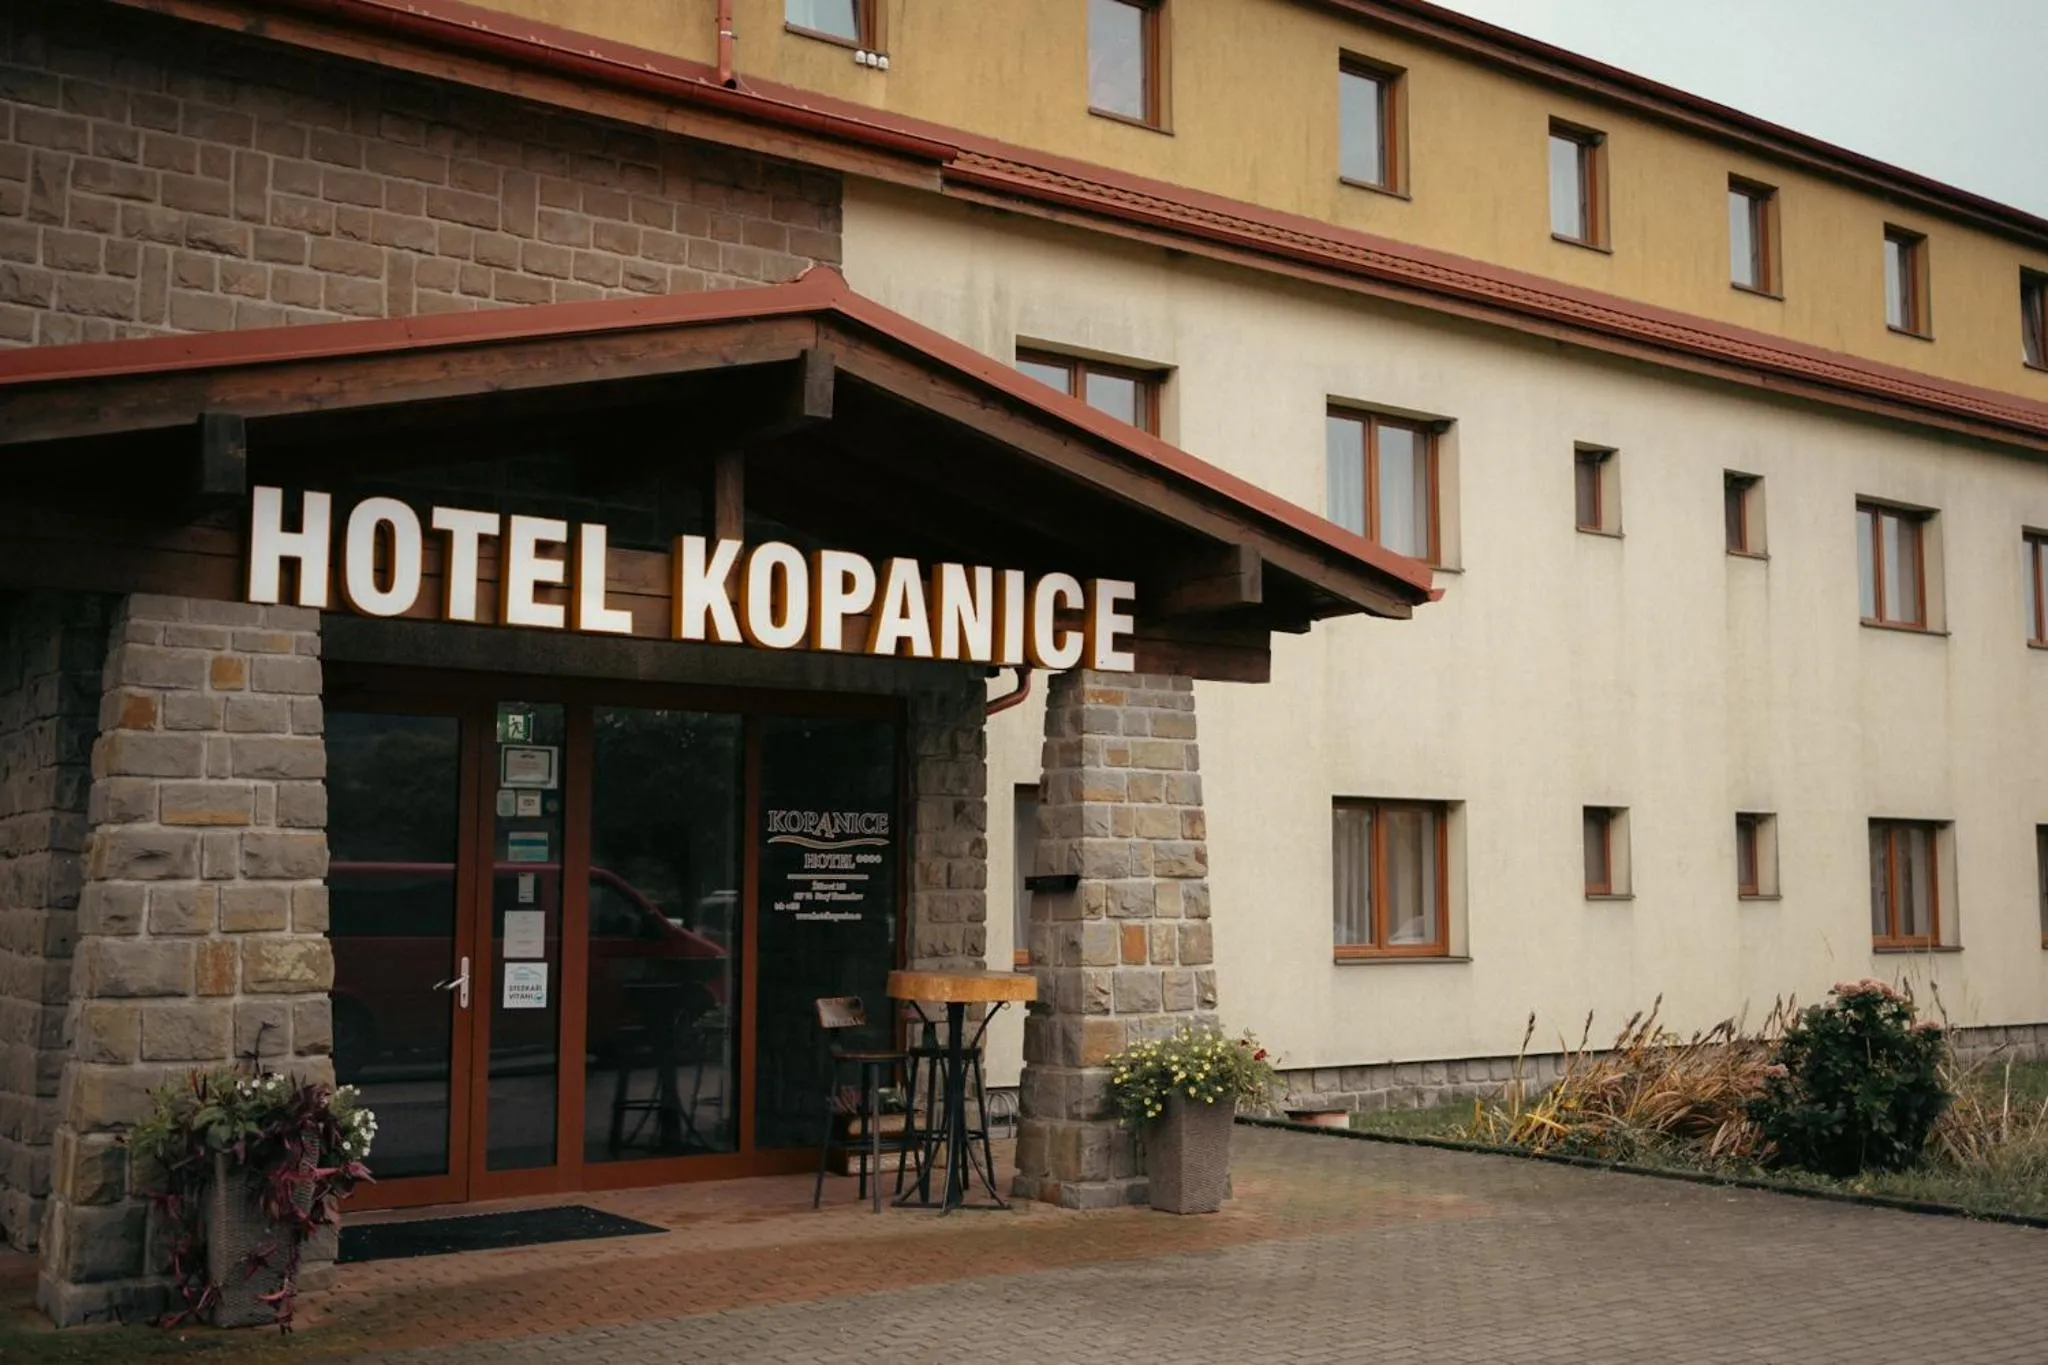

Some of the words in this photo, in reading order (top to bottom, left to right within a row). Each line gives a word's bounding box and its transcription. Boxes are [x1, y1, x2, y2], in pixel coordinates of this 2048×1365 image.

[248, 485, 633, 634] HOTEL
[674, 534, 1136, 672] KOPANICE
[767, 810, 889, 838] KOPANICE
[804, 853, 855, 869] HOTEL
